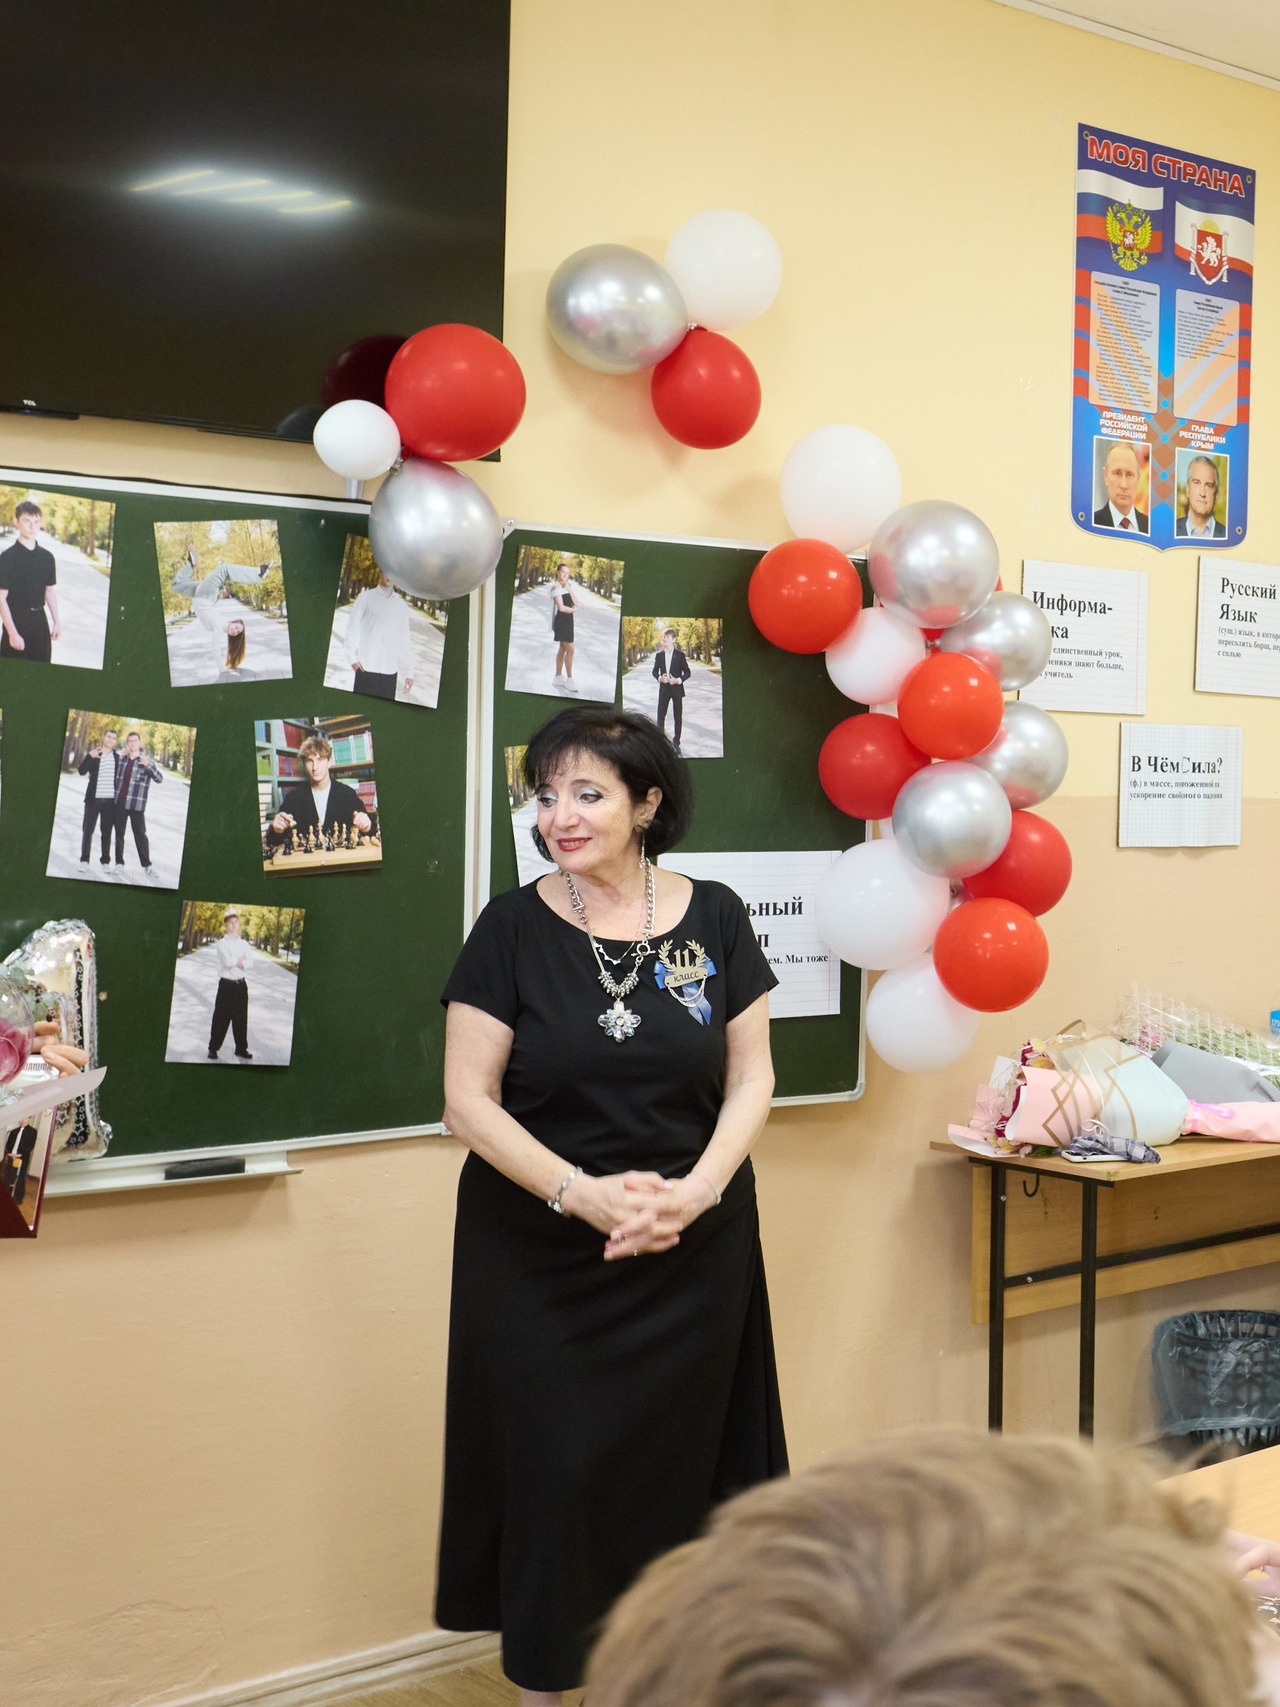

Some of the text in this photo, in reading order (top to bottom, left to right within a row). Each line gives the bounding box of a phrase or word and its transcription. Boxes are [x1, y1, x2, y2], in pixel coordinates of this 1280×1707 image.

[1088, 135, 1245, 197] МОЯ СТРАНА
[1102, 410, 1146, 424] ПРЕЗИДЕНТ
[1099, 418, 1148, 432] РОССИЙСКОЙ
[1191, 424, 1214, 435] ГЛАВА
[1101, 427, 1147, 440] ФЕДЕРАЦИИ
[1179, 430, 1226, 444] РЕСПУБЛИКИ
[1191, 440, 1214, 450] КРЫМ
[1220, 577, 1277, 600] Русский
[1032, 590, 1113, 617] Информа-
[1219, 603, 1258, 623] Язык
[1051, 625, 1069, 639] ка
[1053, 646, 1123, 659] единственный урок,
[1222, 650, 1242, 658] солью
[1074, 660, 1095, 668] знают
[1131, 755, 1142, 773] В
[1147, 755, 1180, 773] Чём
[1129, 792, 1167, 800] ускорение
[745, 896, 803, 917] ьный
[673, 948, 690, 968] 11
[785, 954, 803, 964] Мы
[805, 955, 829, 963] тоже
[673, 971, 700, 983] класс
